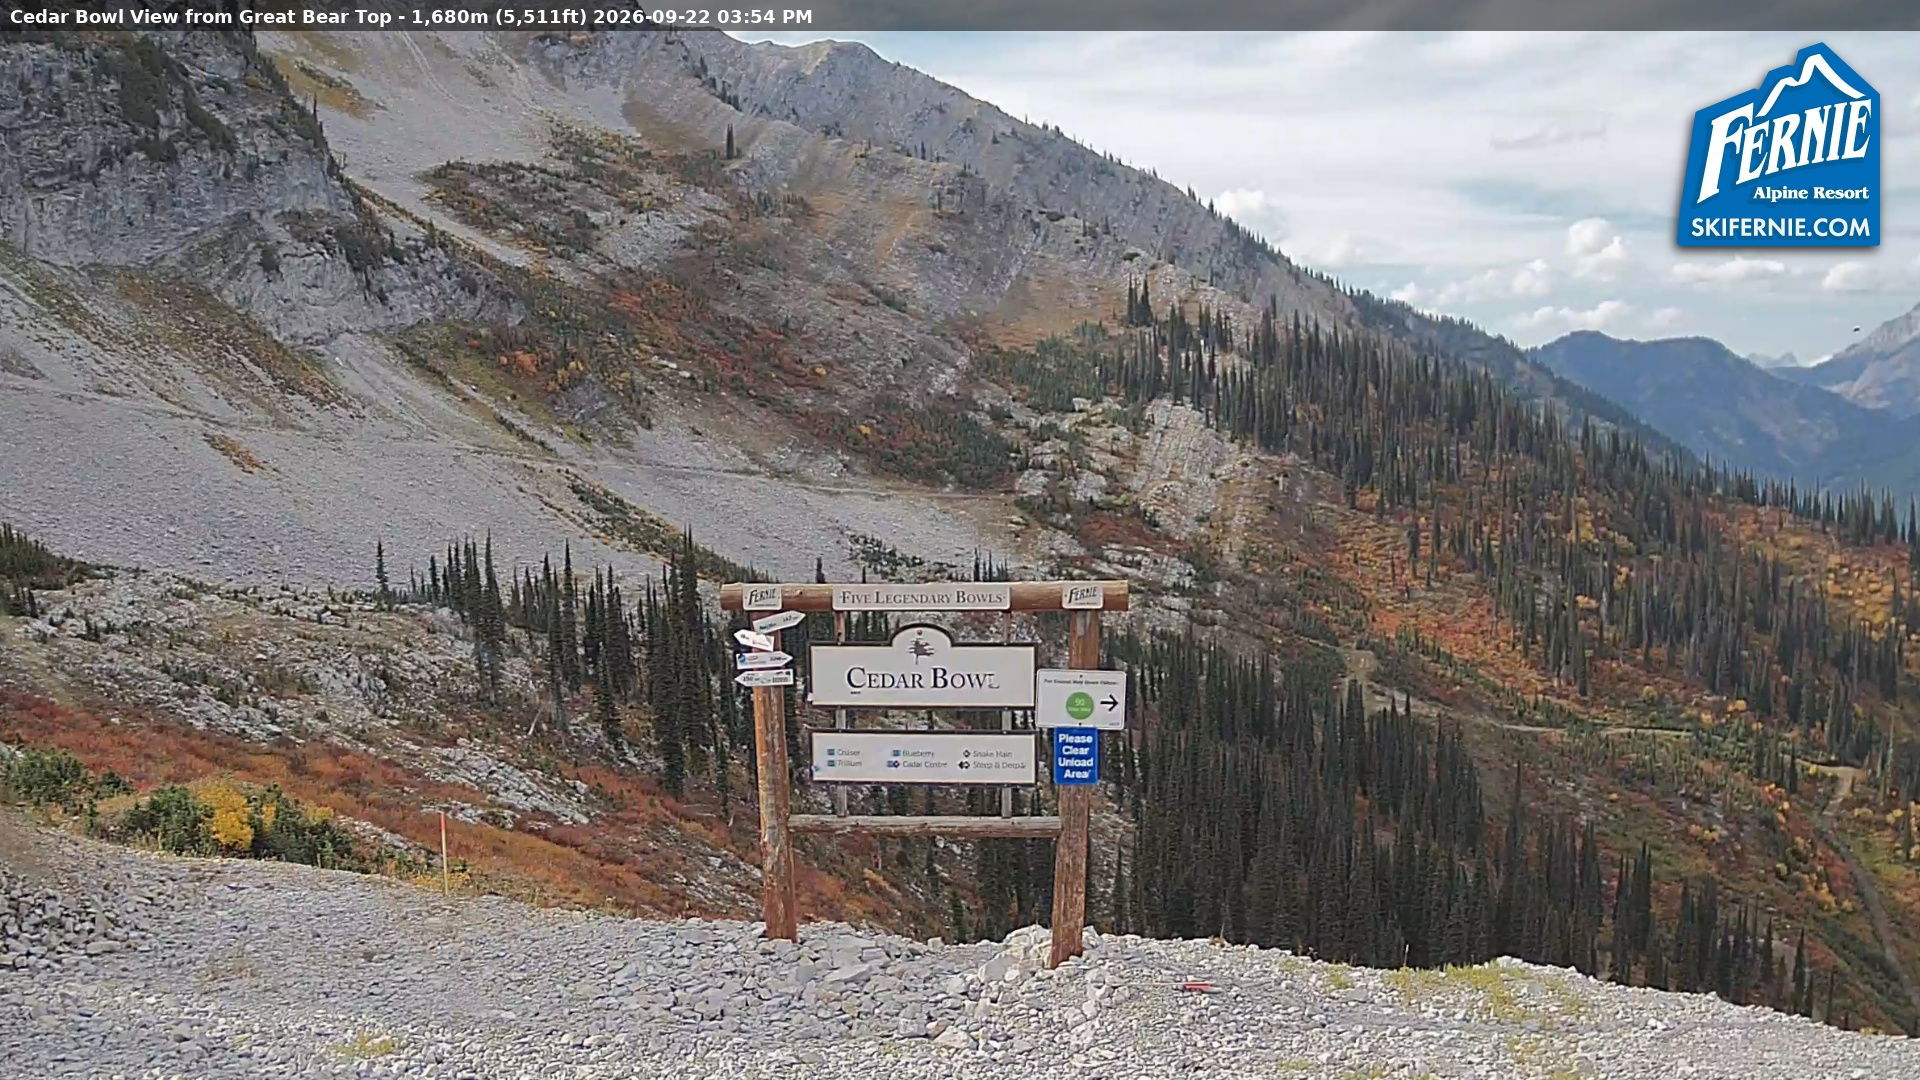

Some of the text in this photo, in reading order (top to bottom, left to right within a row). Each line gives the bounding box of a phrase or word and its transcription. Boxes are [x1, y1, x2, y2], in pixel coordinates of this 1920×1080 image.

[841, 590, 1002, 604] FIVE LEGENDARY BOWLS
[846, 666, 924, 689] CEDAR
[1058, 733, 1093, 743] Please
[902, 749, 935, 758] Blueberry
[1062, 745, 1090, 755] Clear
[1058, 757, 1094, 767] Unload
